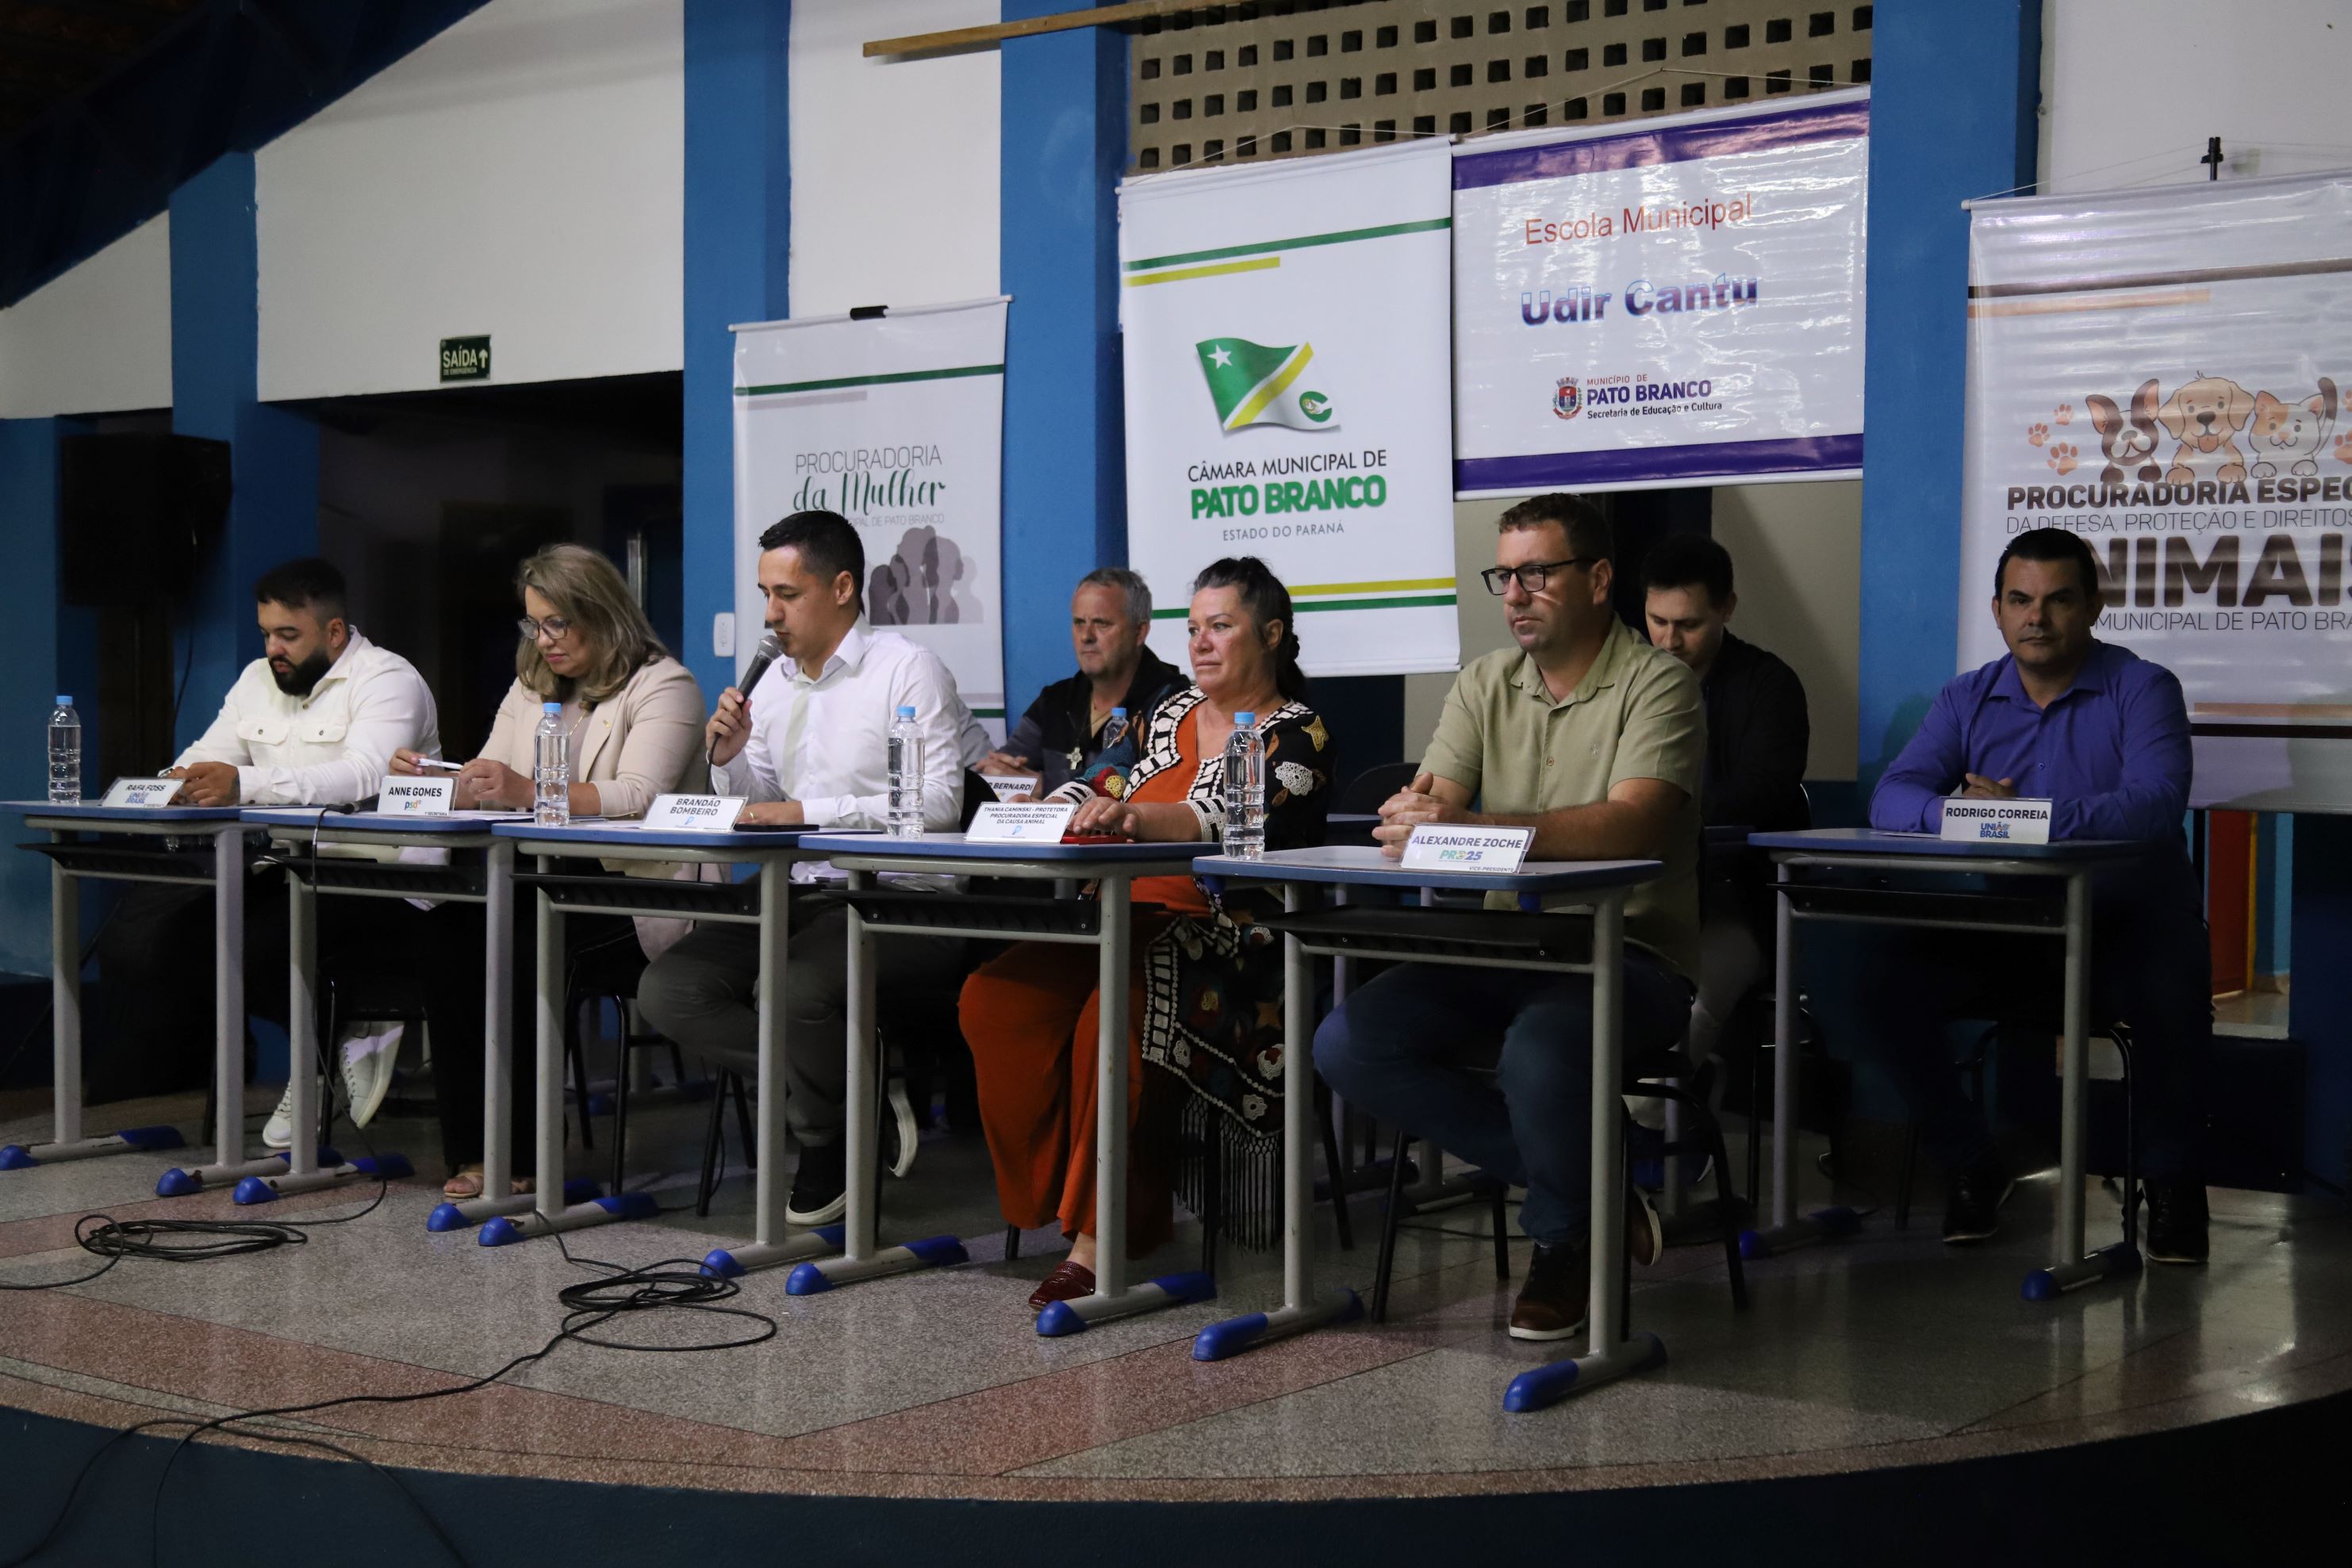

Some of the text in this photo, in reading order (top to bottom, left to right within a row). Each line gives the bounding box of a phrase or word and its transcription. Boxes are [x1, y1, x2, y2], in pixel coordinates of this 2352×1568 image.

[1525, 193, 1752, 245] Escola Municipal
[1521, 273, 1758, 325] Udir Cantu
[443, 344, 478, 368] SAÍDA
[1587, 374, 1630, 386] MUNICÍPIO
[1587, 380, 1712, 405] PATO BRANCO
[1587, 408, 1628, 419] Secretaria
[1630, 408, 1640, 416] de
[1642, 405, 1682, 416] Educação
[1691, 402, 1722, 412] Cultura
[796, 445, 942, 474] PROCURADORIA
[1188, 450, 1387, 482] CÂMARA MUNICIPAL DE
[793, 468, 946, 516] da Mulher
[1191, 474, 1387, 519] PATO BRANCO
[2008, 481, 2250, 510] PROCURADORIA
[909, 514, 945, 523] BRANCO
[2007, 508, 2352, 535] DA DEFESA, PROTEÇÃO E DIREITO
[1223, 519, 1345, 541] ESTADO DO PARANÁ
[2095, 611, 2209, 631] MUNICIPAL
[2216, 611, 2243, 631] DE
[2251, 611, 2307, 631] PATO
[388, 787, 443, 797] ANNE GOMES
[993, 783, 1034, 792] BERNARDI
[670, 807, 718, 816] BOMBEIRO
[676, 797, 721, 807] BRANDÃO
[1945, 807, 2048, 820] RODRIGO CORREIA
[1411, 836, 1523, 849] ALEXANDRE ZOCHE
[1980, 830, 2010, 839] BRASIL
